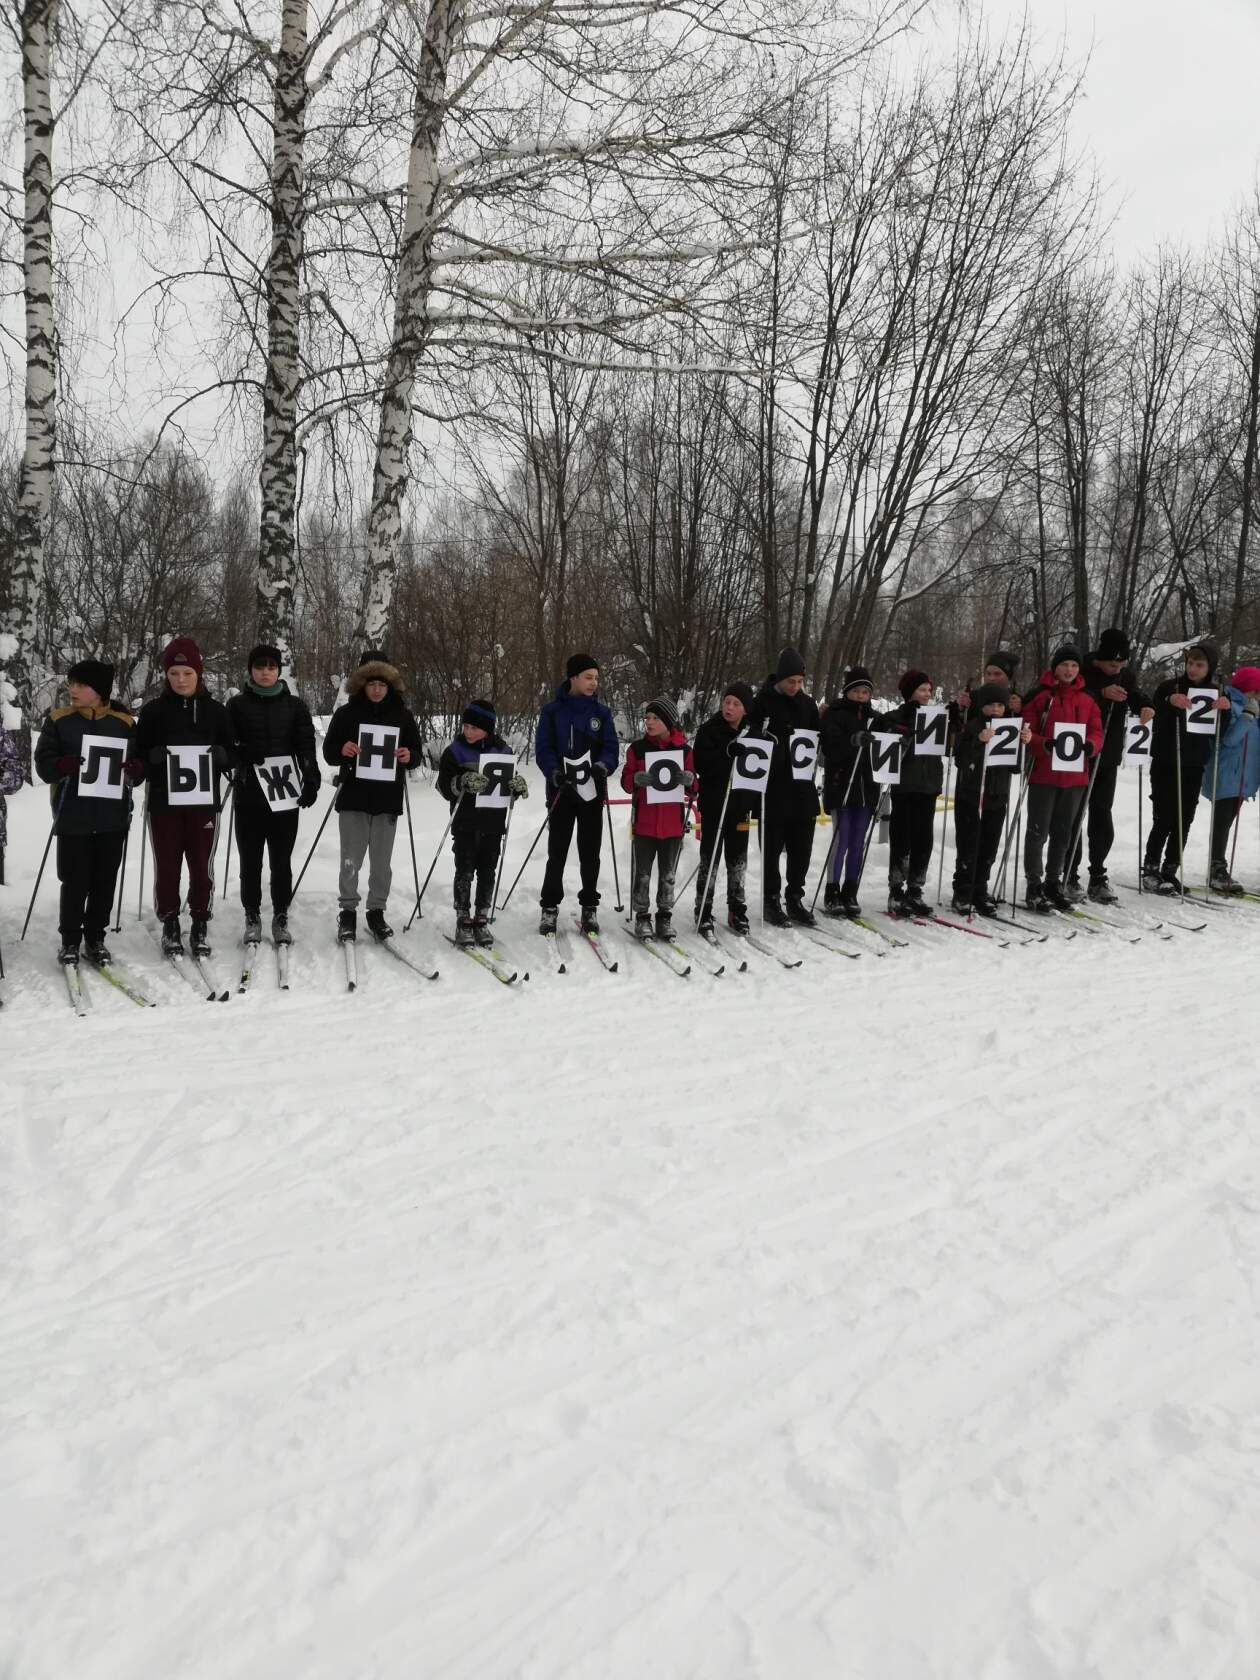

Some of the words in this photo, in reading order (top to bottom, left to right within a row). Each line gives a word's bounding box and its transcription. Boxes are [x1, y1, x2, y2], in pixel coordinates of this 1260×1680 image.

[1188, 695, 1215, 725] 2
[915, 713, 948, 745] И
[989, 725, 1019, 756] 2
[1128, 725, 1150, 755] 2
[81, 745, 124, 785] Л
[359, 732, 397, 769] Н
[736, 747, 769, 779] С
[790, 736, 815, 768] С
[871, 740, 899, 773] И
[169, 754, 211, 793] Ы
[258, 764, 300, 802] Ж
[478, 762, 515, 797] Я
